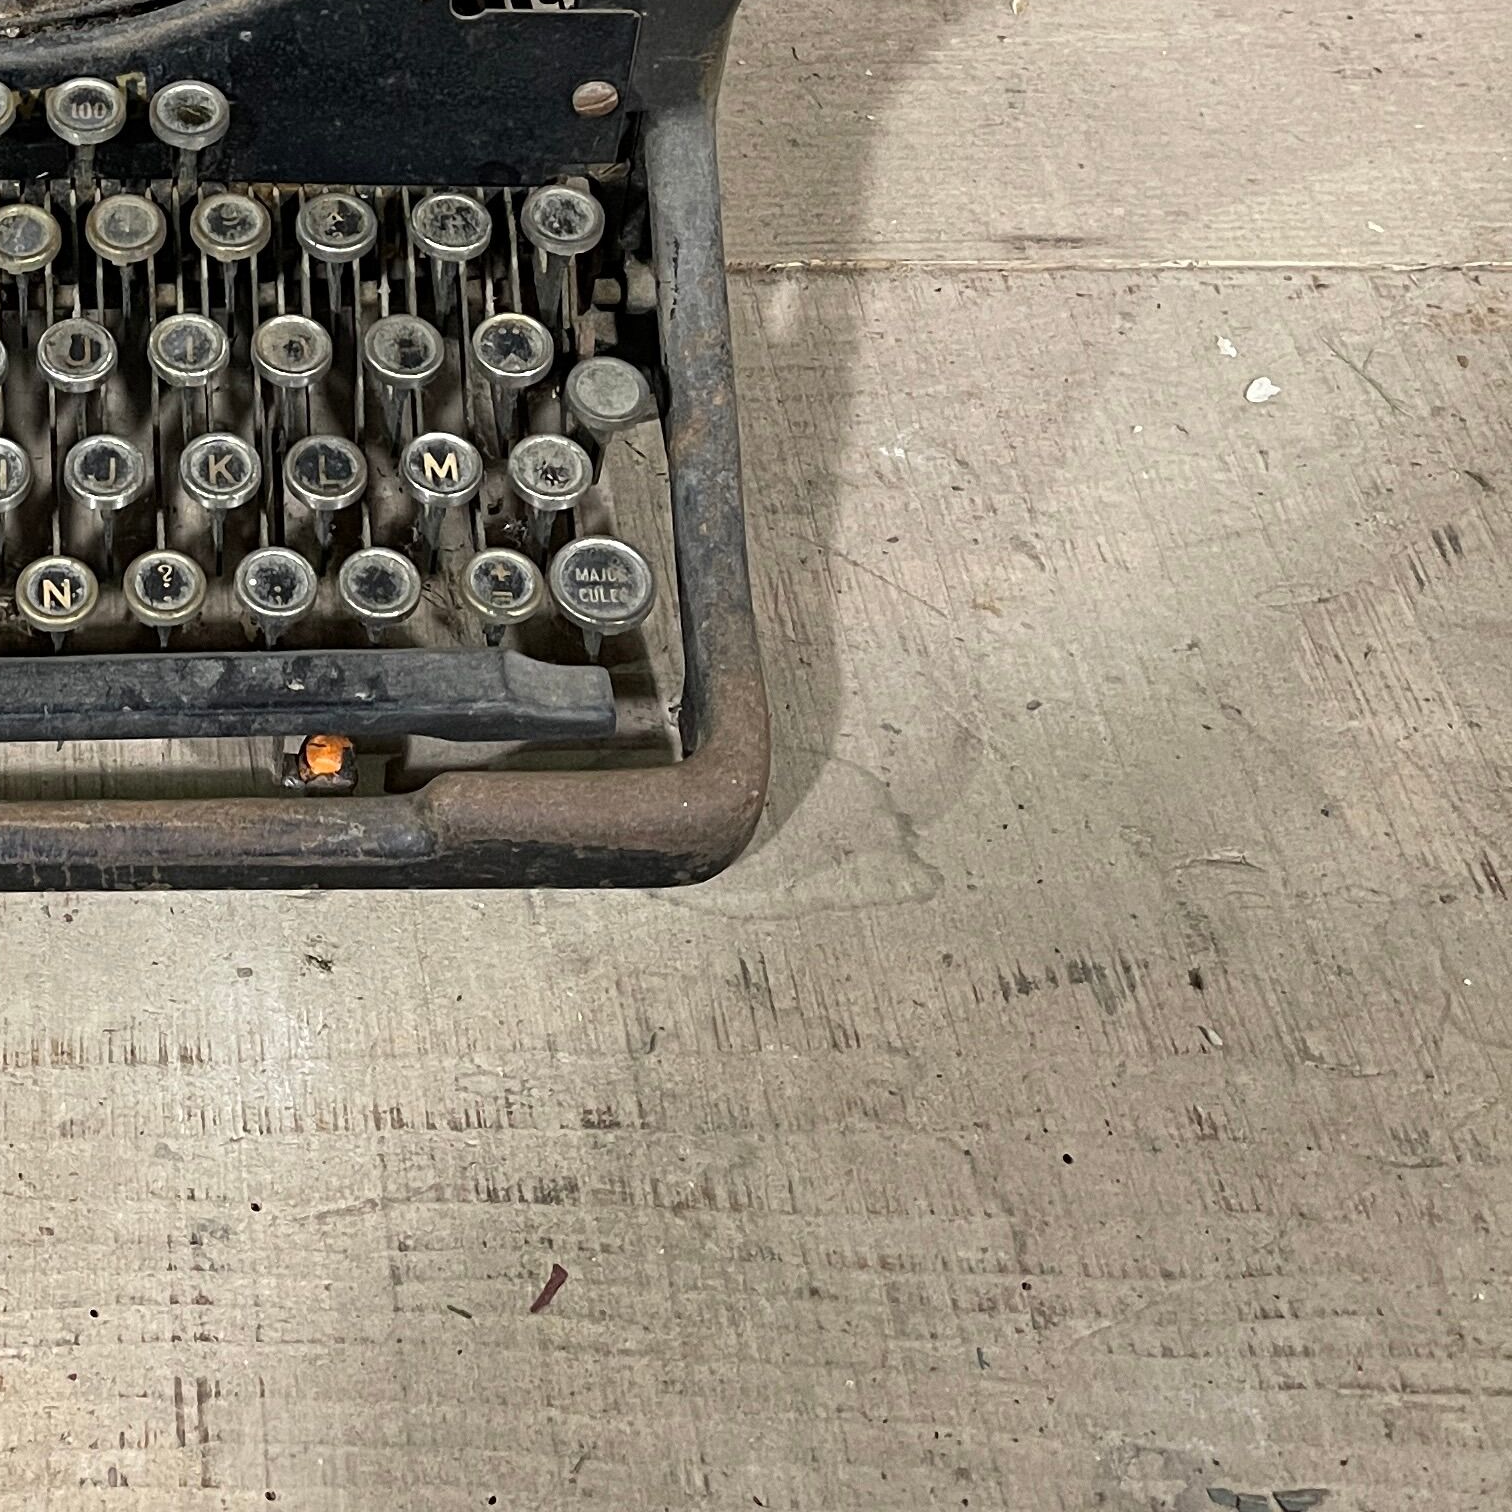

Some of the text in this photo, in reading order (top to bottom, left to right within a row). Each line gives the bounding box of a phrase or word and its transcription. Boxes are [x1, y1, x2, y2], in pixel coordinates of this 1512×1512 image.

[71, 100, 107, 120] 100
[88, 456, 116, 487] J
[207, 454, 238, 485] K
[318, 455, 346, 485] L
[423, 451, 460, 483] M
[157, 563, 173, 588] ?
[42, 577, 72, 610] N
